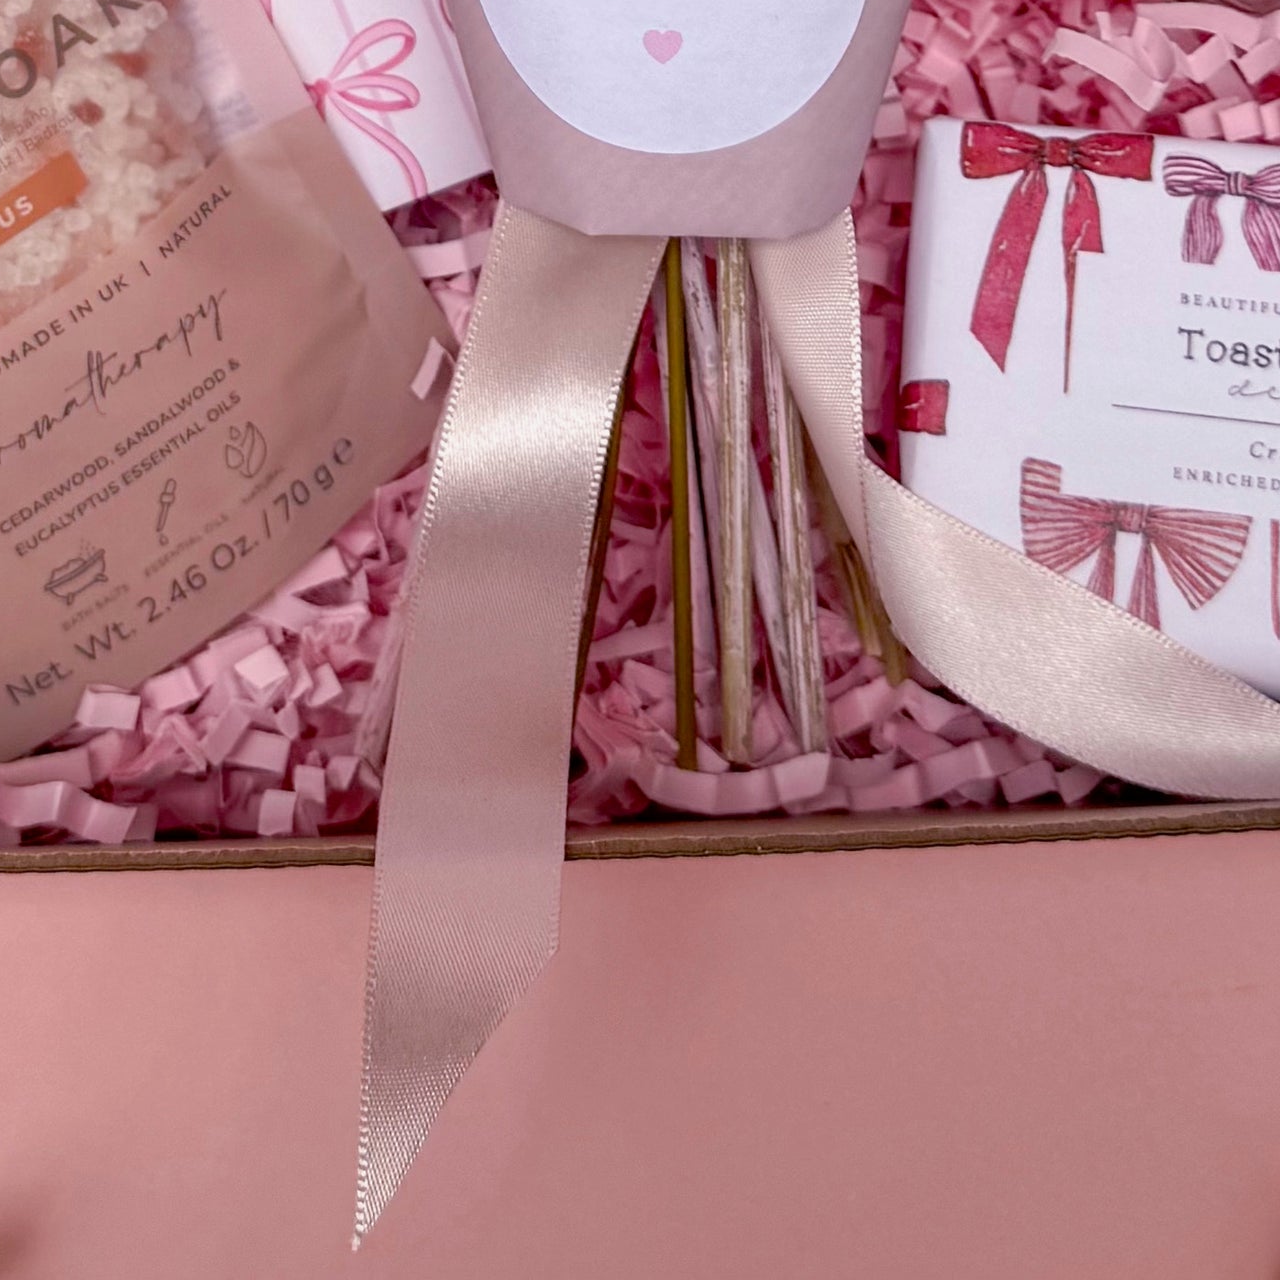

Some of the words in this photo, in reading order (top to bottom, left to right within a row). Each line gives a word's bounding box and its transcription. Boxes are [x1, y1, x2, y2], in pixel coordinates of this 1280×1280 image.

[69, 299, 93, 323] IN
[98, 274, 130, 302] UK
[159, 184, 232, 259] NATURAL
[0, 455, 115, 534] CEDARWOOD,
[114, 373, 227, 457] SANDALWOOD
[228, 358, 241, 372] &
[14, 481, 120, 557] EUCALYPTUS
[121, 423, 206, 487] ESSENTIAL
[206, 391, 242, 423] OILS
[74, 620, 138, 661] Wt.
[137, 564, 208, 623] 2.46
[211, 533, 260, 571] Oz.
[273, 479, 310, 523] 70
